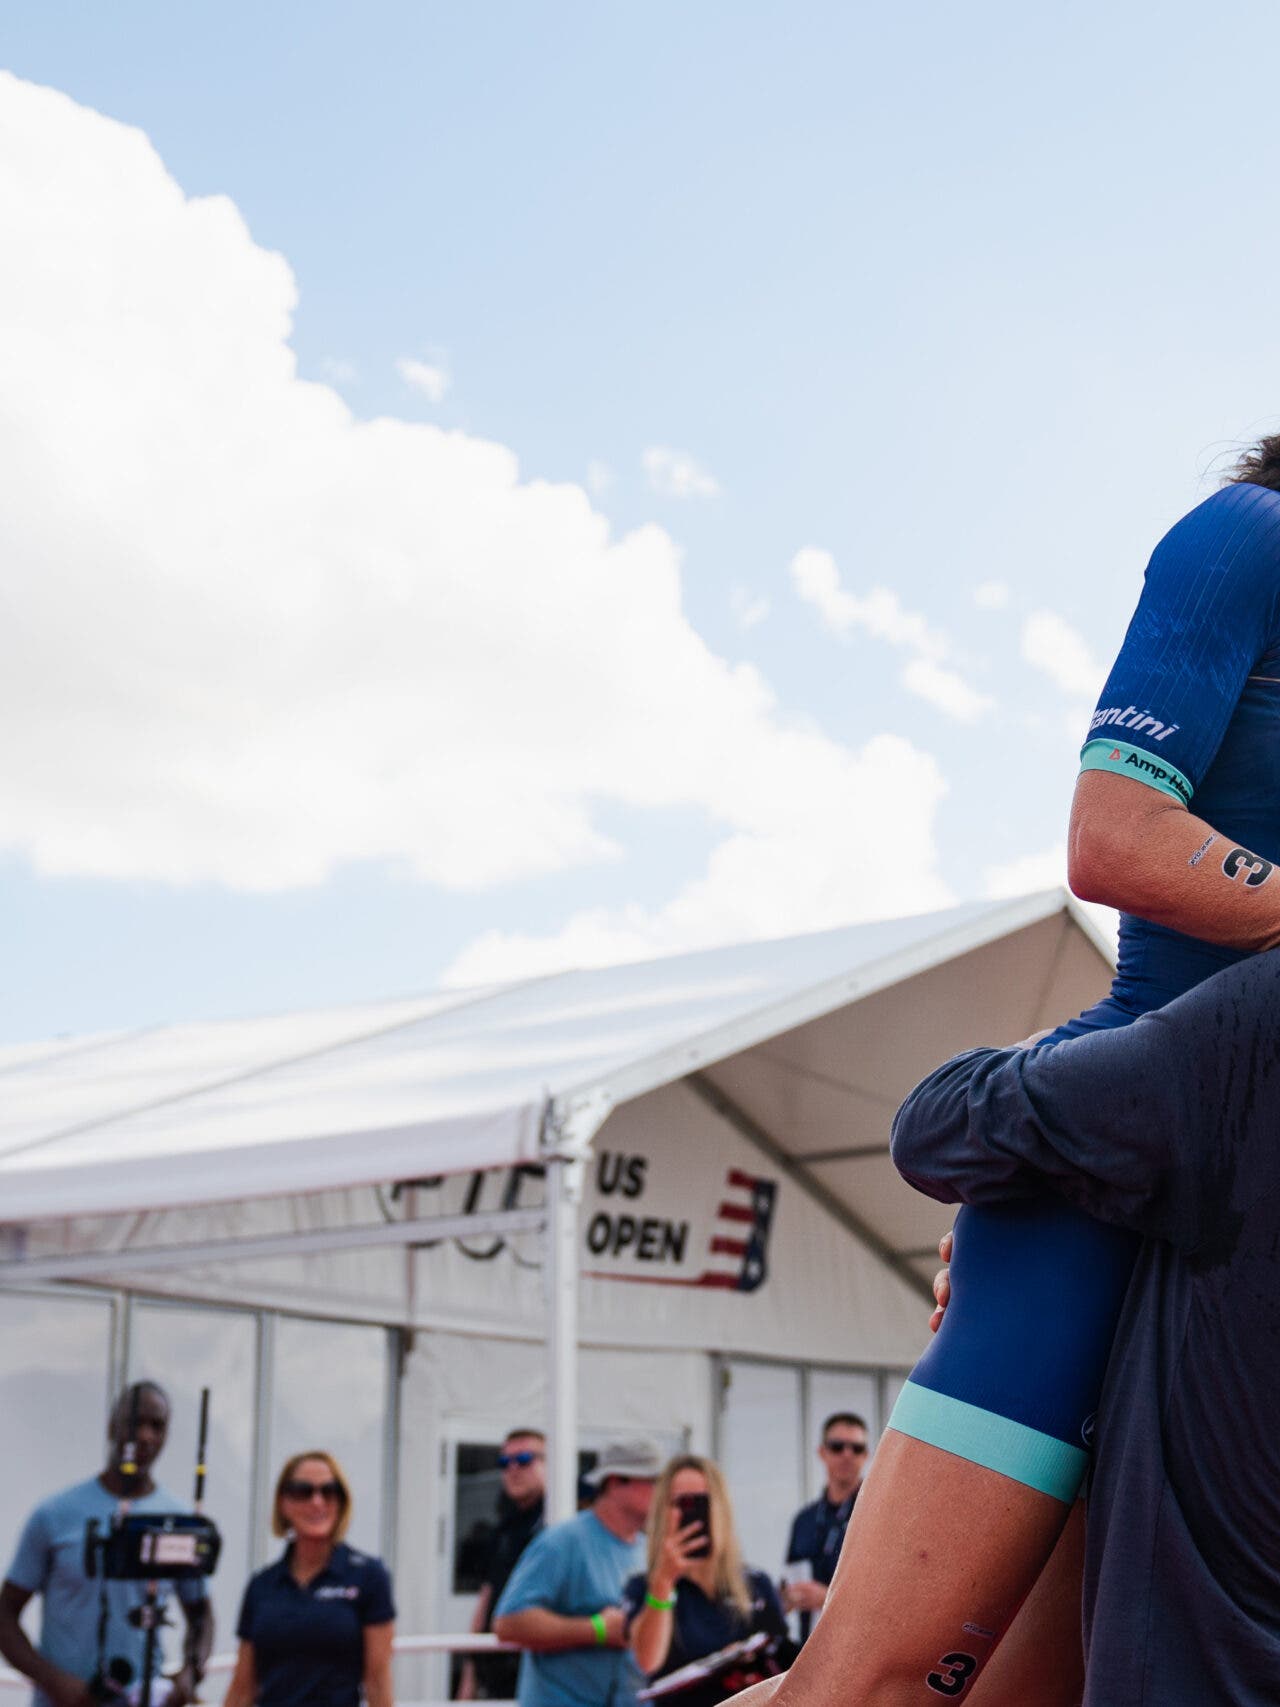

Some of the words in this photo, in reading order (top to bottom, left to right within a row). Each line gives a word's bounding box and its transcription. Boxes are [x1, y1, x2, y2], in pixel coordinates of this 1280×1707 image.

[1124, 752, 1168, 780] Amp
[1221, 847, 1274, 888] 3
[597, 1152, 647, 1199] US
[586, 1211, 690, 1263] OPEN
[925, 1651, 978, 1697] 3
